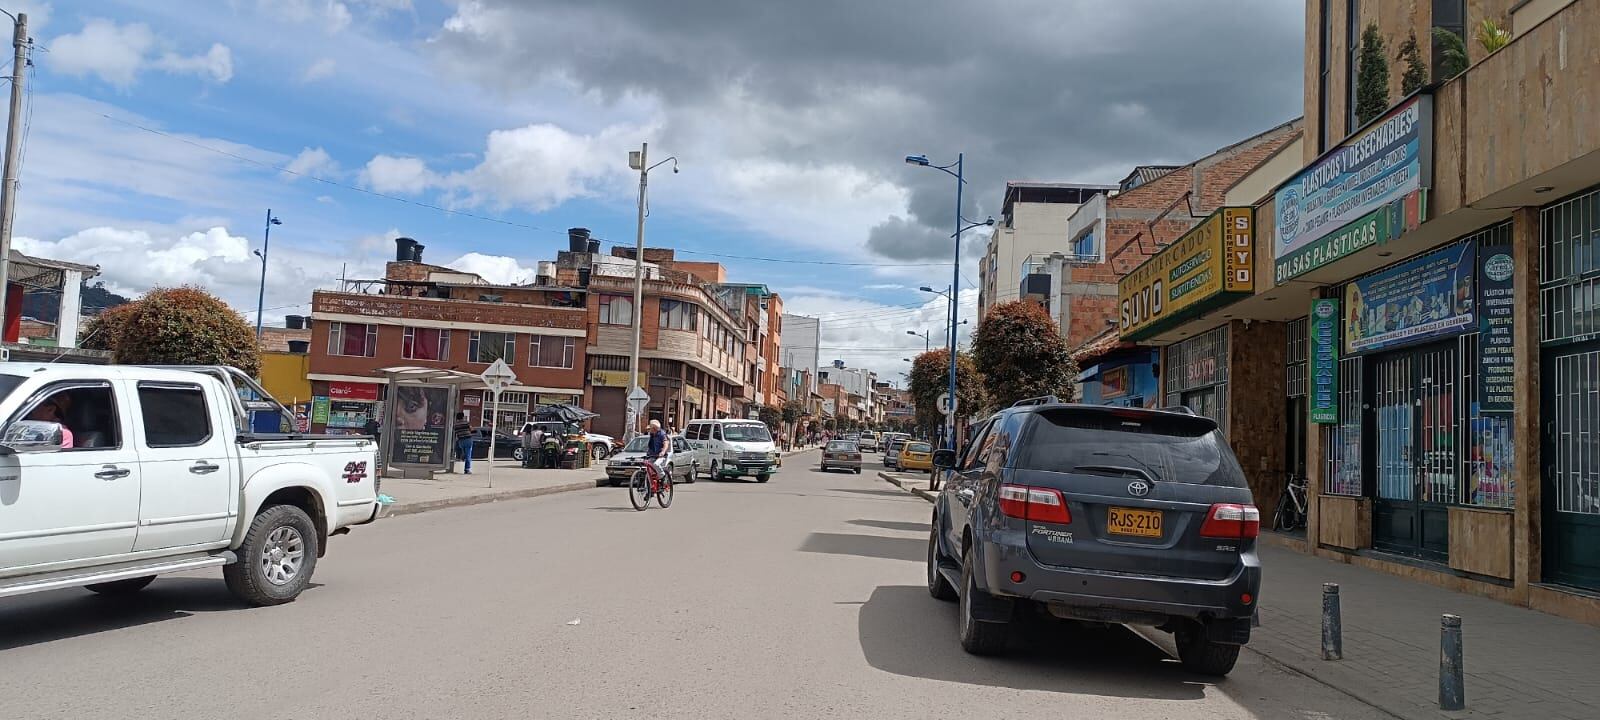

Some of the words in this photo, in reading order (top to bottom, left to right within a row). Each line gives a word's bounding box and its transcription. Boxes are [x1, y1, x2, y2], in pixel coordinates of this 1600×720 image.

[1302, 156, 1341, 198] PLASTICOS
[1342, 150, 1348, 172] Y
[1349, 107, 1413, 168] DESECHABLES
[1123, 223, 1212, 293] SUPERMERCADOS
[1226, 210, 1234, 289] SUPERMERCADOS
[1235, 216, 1250, 283] SUYO
[1277, 249, 1311, 281] BOLSAS
[1121, 278, 1163, 331] SUYO
[1486, 297, 1514, 306] INVERNADER
[1445, 316, 1470, 326] GENERAL
[1497, 346, 1514, 354] PEGANT
[1188, 358, 1214, 380] SUYO
[1031, 528, 1073, 538] FORTUNER
[1047, 535, 1073, 545] URBANA
